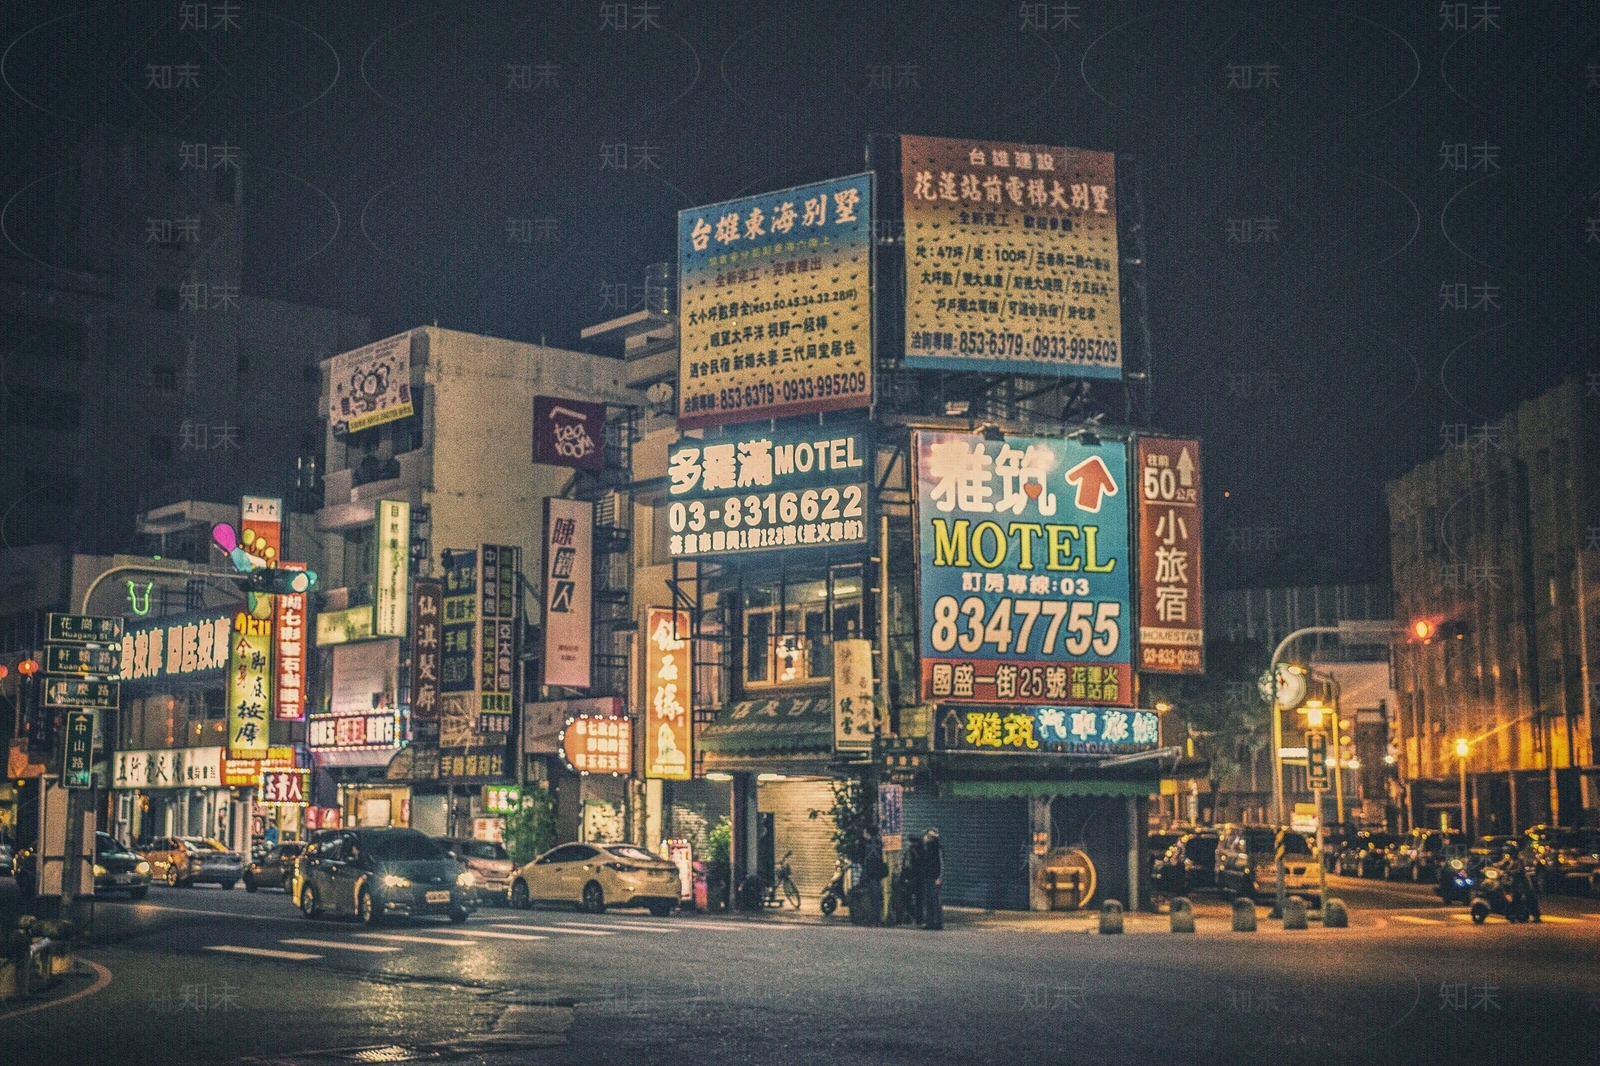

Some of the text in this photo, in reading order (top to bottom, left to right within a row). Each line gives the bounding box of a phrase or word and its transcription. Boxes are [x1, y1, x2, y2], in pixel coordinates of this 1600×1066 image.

[969, 148, 1054, 171] 台雄建設
[913, 170, 1109, 215] 花蓮站前電梯大別墅
[691, 188, 860, 250] 台雄東海別墅
[668, 437, 863, 495] 多羅滿 MOTEL
[930, 441, 1056, 516] 雅筑
[1143, 467, 1176, 501] 50
[669, 485, 863, 533] 03-8316622
[932, 519, 1116, 573] MOTEL
[1154, 509, 1189, 623] 小旅宿
[930, 596, 1121, 657] 8347755
[1143, 630, 1199, 643] HOMESTAY
[932, 664, 1068, 699] 國盛一街25號
[71, 721, 87, 769] 中山路
